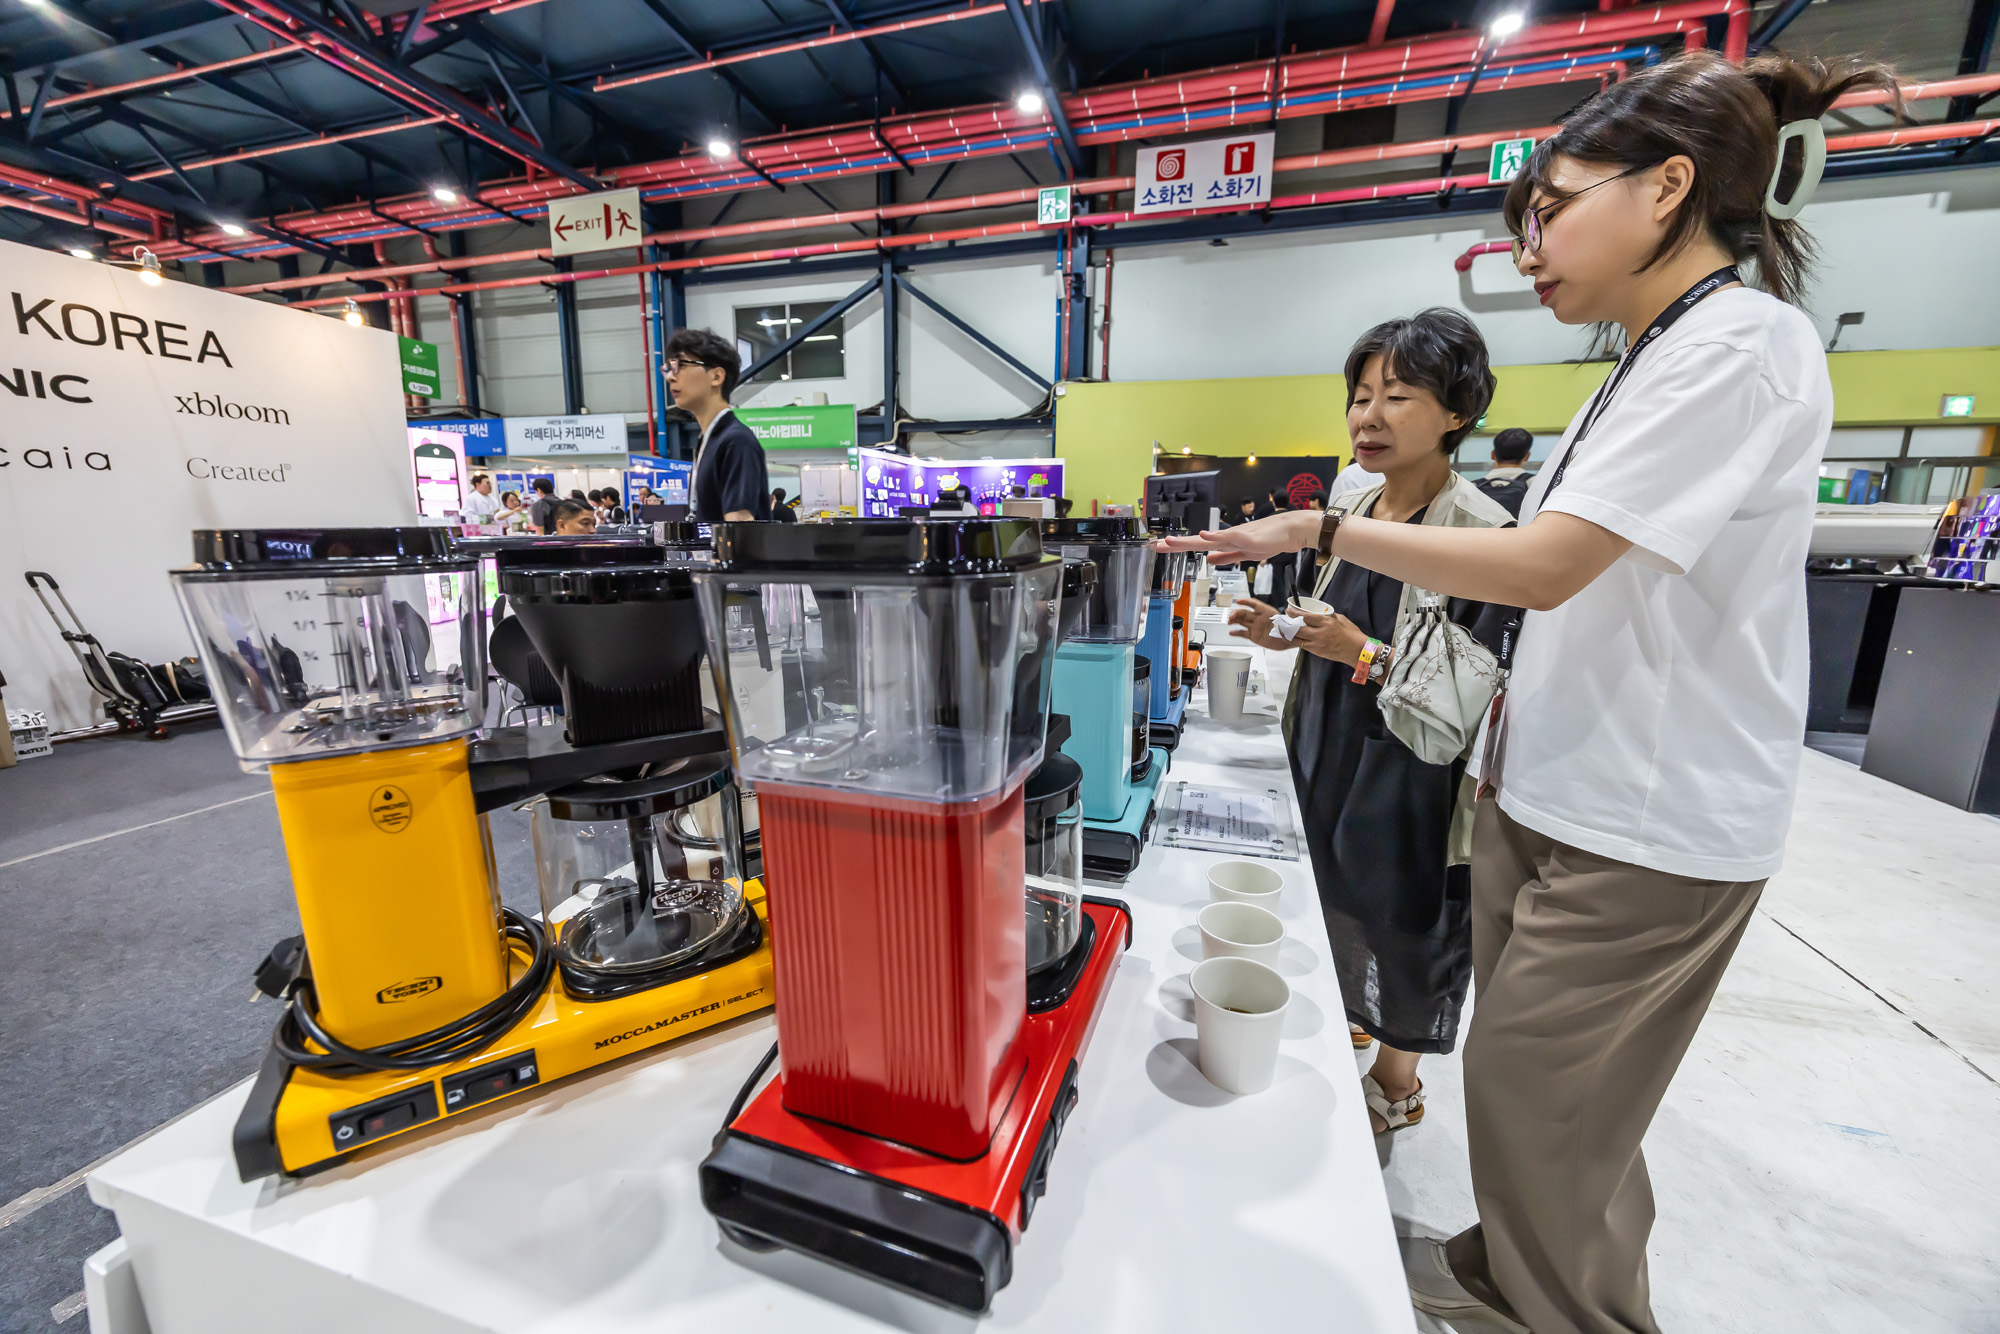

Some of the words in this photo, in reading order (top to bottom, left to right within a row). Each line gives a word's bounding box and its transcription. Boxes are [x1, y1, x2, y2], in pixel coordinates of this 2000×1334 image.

[1141, 183, 1193, 206] 소화전
[1207, 175, 1261, 200] 소화기
[575, 218, 602, 231] EXIT
[11, 292, 233, 368] KOREA
[175, 392, 291, 425] xbloom
[469, 423, 488, 437] 머신
[565, 425, 604, 440] 커피머신
[594, 1001, 721, 1051] MOCCAMASTER
[727, 987, 765, 1005] SELECT
